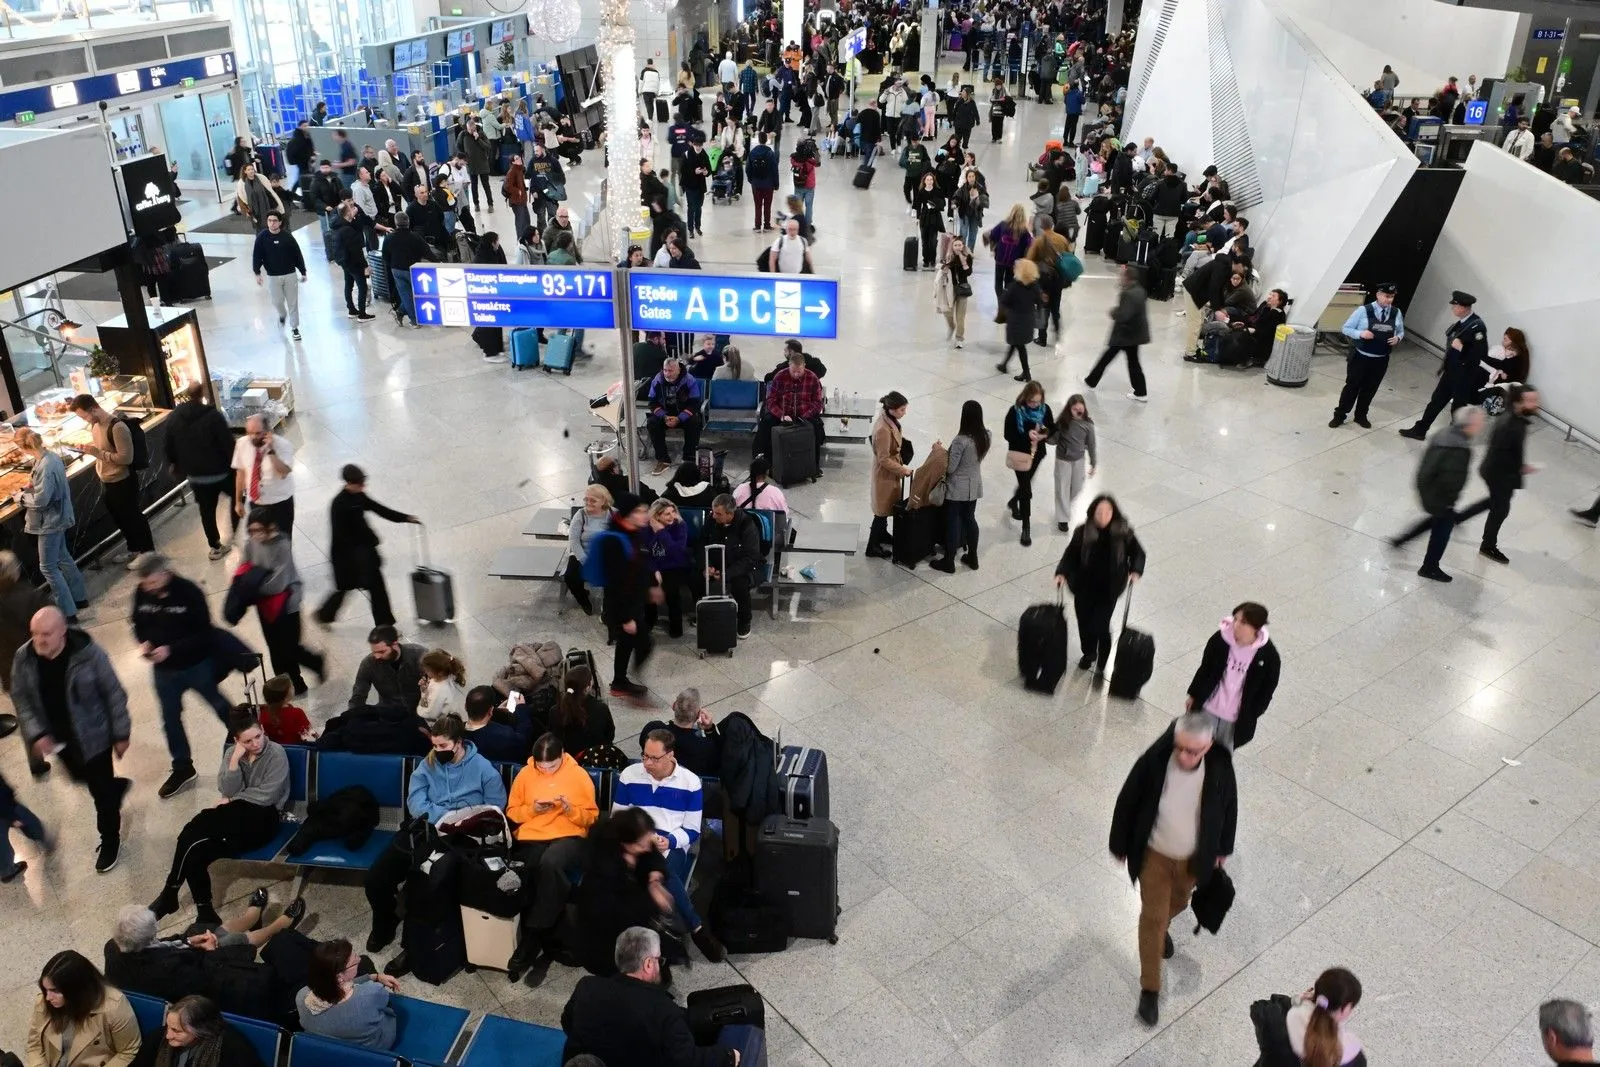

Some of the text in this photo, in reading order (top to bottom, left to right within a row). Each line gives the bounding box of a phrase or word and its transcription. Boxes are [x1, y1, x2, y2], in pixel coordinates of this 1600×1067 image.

[1469, 106, 1483, 119] 16
[542, 274, 606, 296] 93-171
[634, 284, 678, 303] Έξοδοι
[472, 301, 511, 312] Τουαλέτες
[639, 303, 672, 320] Gates
[685, 287, 772, 325] A B C
